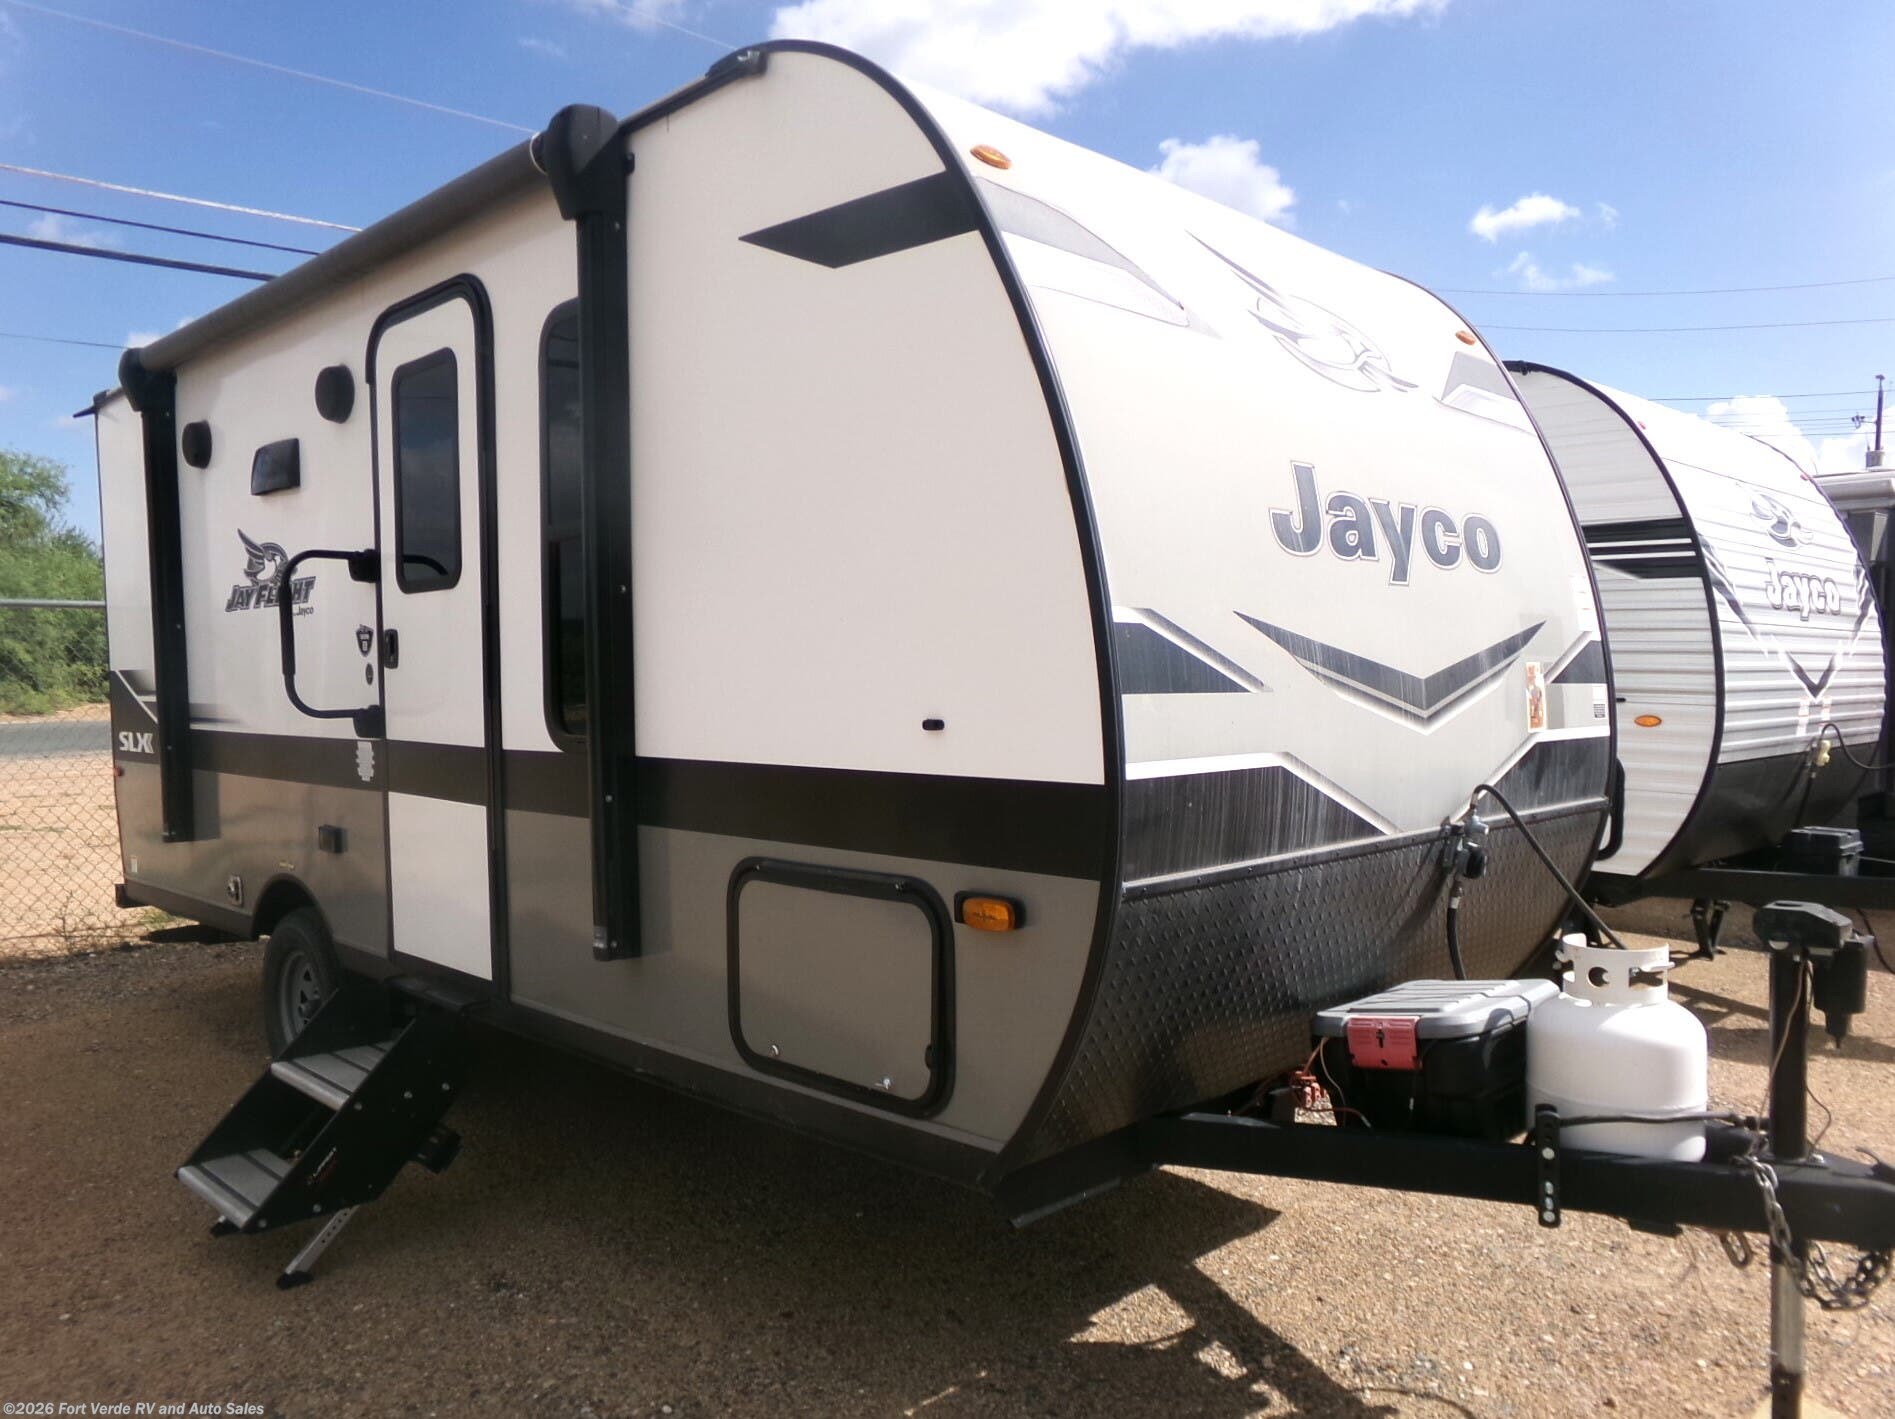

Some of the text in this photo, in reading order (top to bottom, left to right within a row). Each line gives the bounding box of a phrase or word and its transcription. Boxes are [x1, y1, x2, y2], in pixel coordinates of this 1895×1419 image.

[1268, 460, 1503, 587] Jayco
[225, 584, 258, 613] JAY
[1764, 556, 1841, 622] Jayco
[118, 731, 155, 754] SLX
